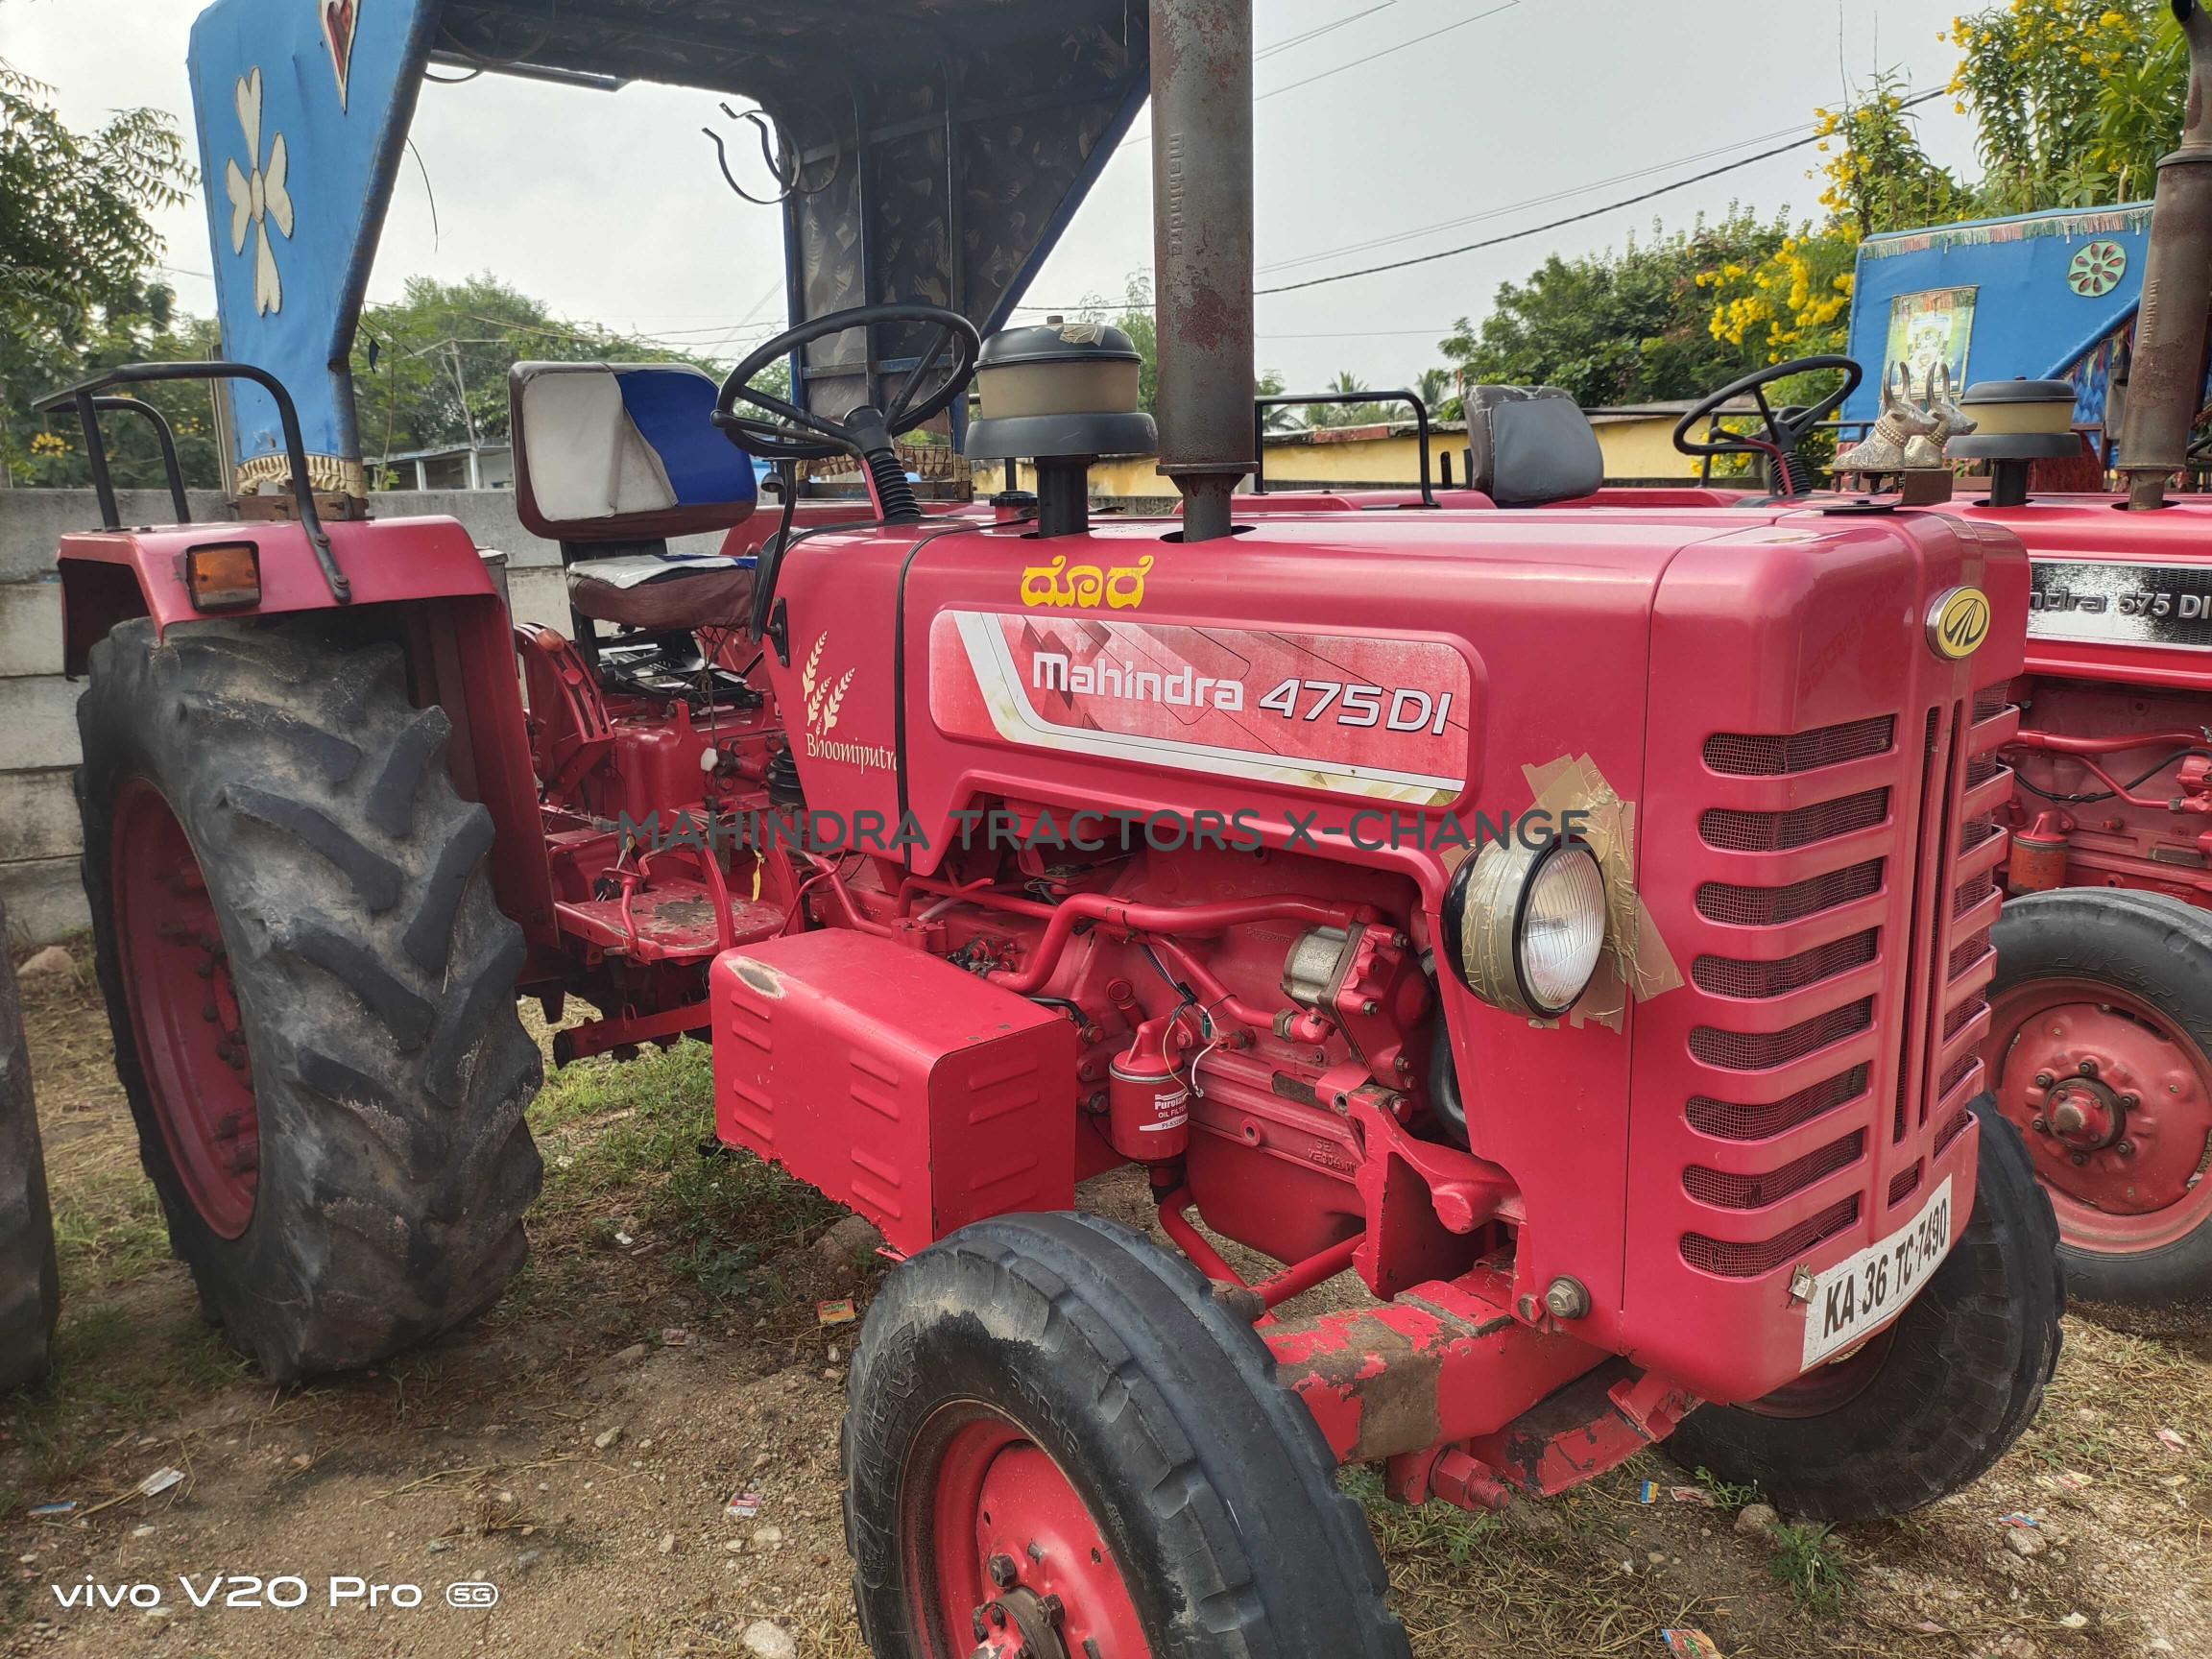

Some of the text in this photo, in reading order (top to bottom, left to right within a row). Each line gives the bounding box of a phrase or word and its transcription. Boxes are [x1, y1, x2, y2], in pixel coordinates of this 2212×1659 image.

[2118, 591, 2172, 616] 575
[1824, 1274, 1854, 1339] KA
[1863, 1253, 1889, 1315] 36
